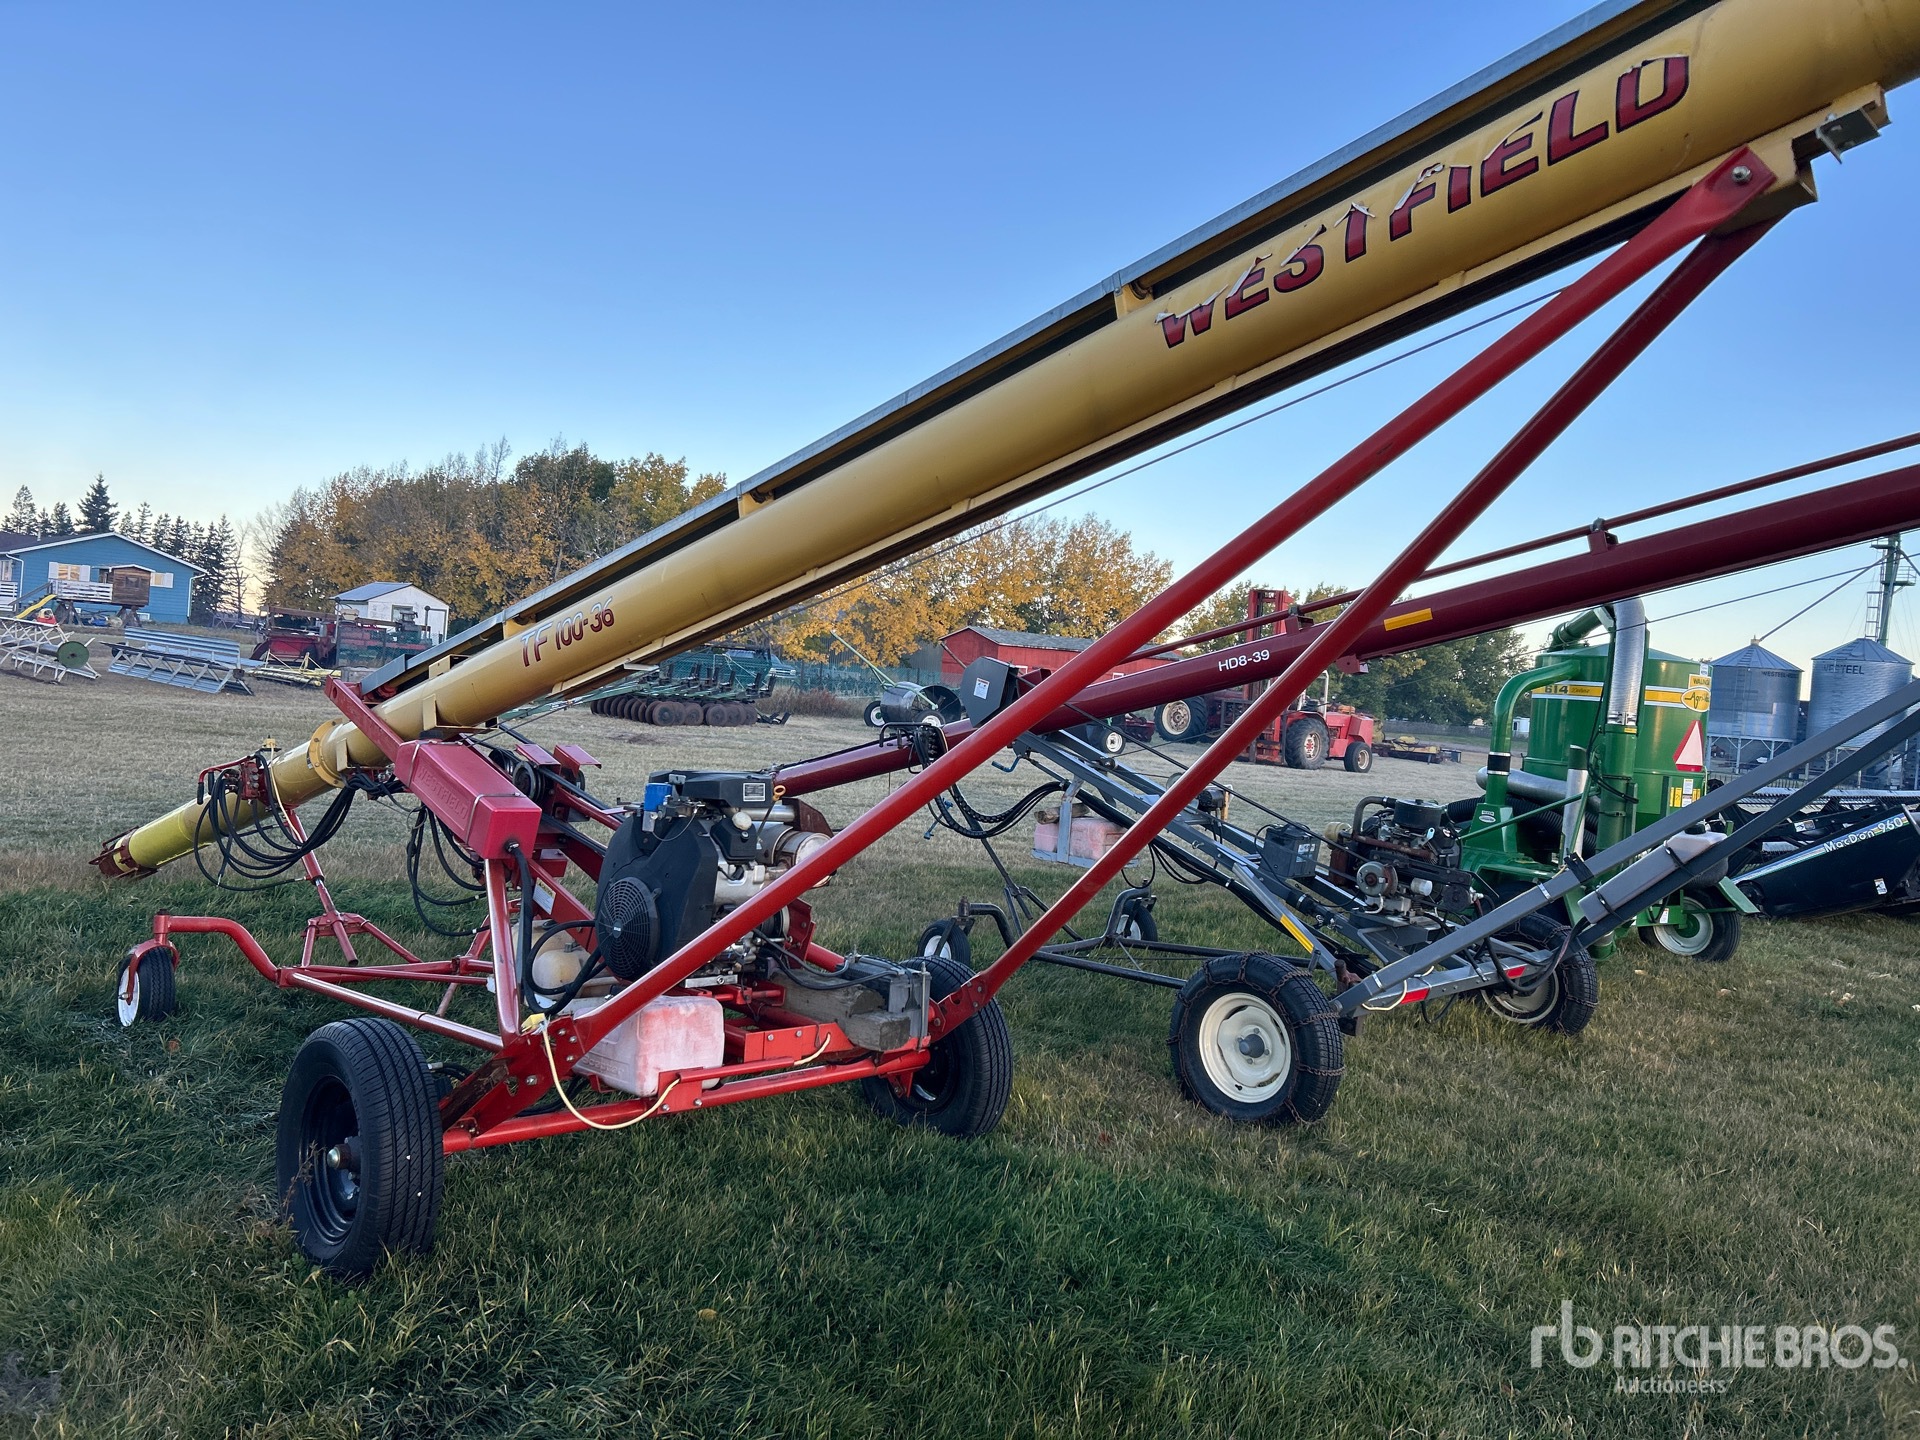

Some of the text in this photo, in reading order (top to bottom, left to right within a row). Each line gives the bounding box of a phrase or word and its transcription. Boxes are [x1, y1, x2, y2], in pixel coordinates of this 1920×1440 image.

[1157, 55, 1690, 348] WESTFIELD
[520, 596, 615, 667] TF 100-36
[1218, 649, 1270, 672] HD8-39
[1544, 685, 1568, 694] 614
[416, 765, 470, 820] WESTFIELD
[1823, 817, 1904, 853] MacDon 960
